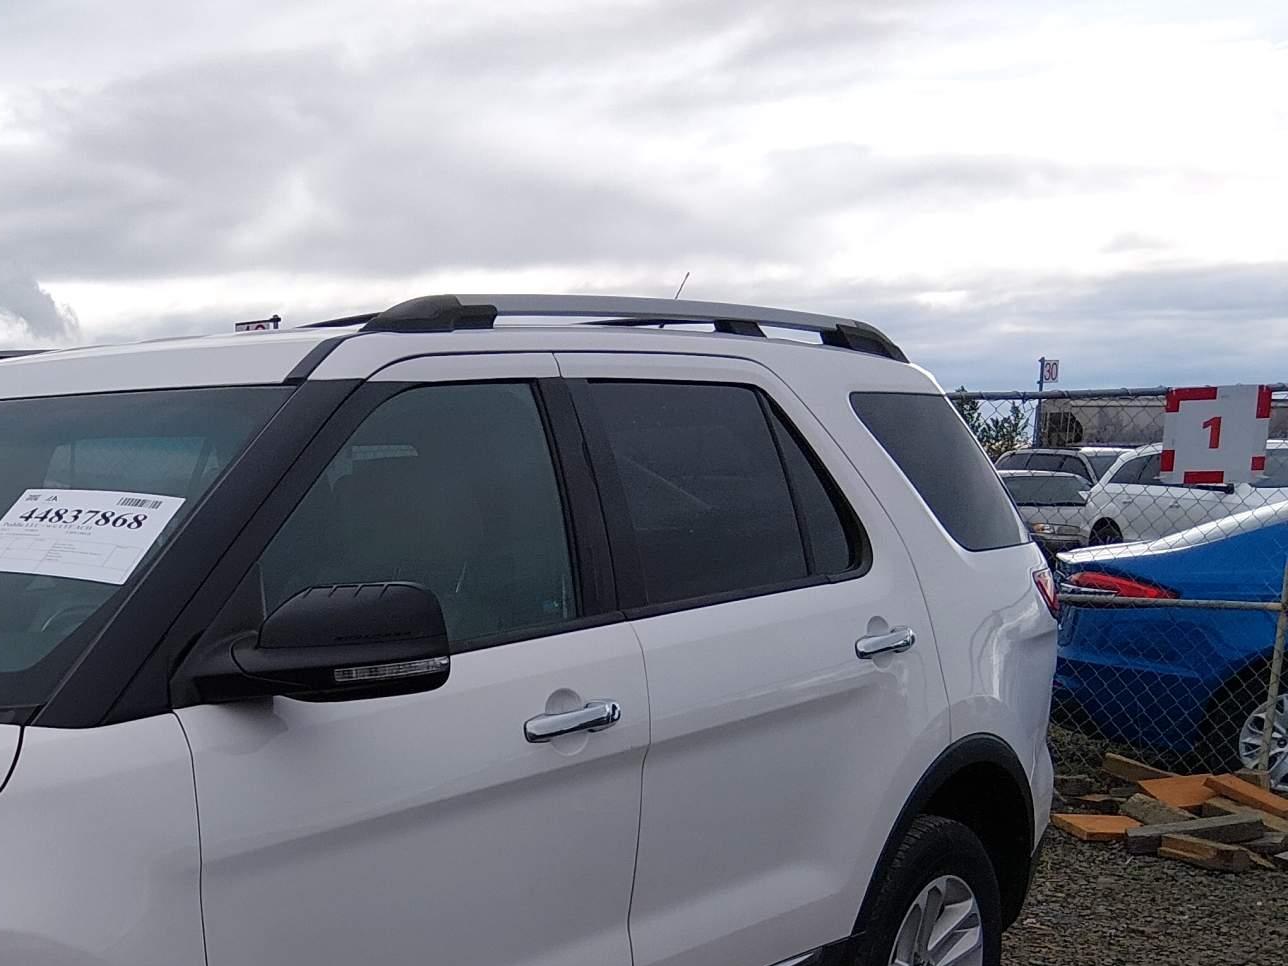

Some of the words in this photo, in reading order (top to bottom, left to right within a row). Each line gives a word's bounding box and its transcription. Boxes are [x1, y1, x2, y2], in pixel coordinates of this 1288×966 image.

[1044, 362, 1058, 381] 30
[1202, 416, 1222, 449] 1
[19, 507, 148, 530] 44837868
